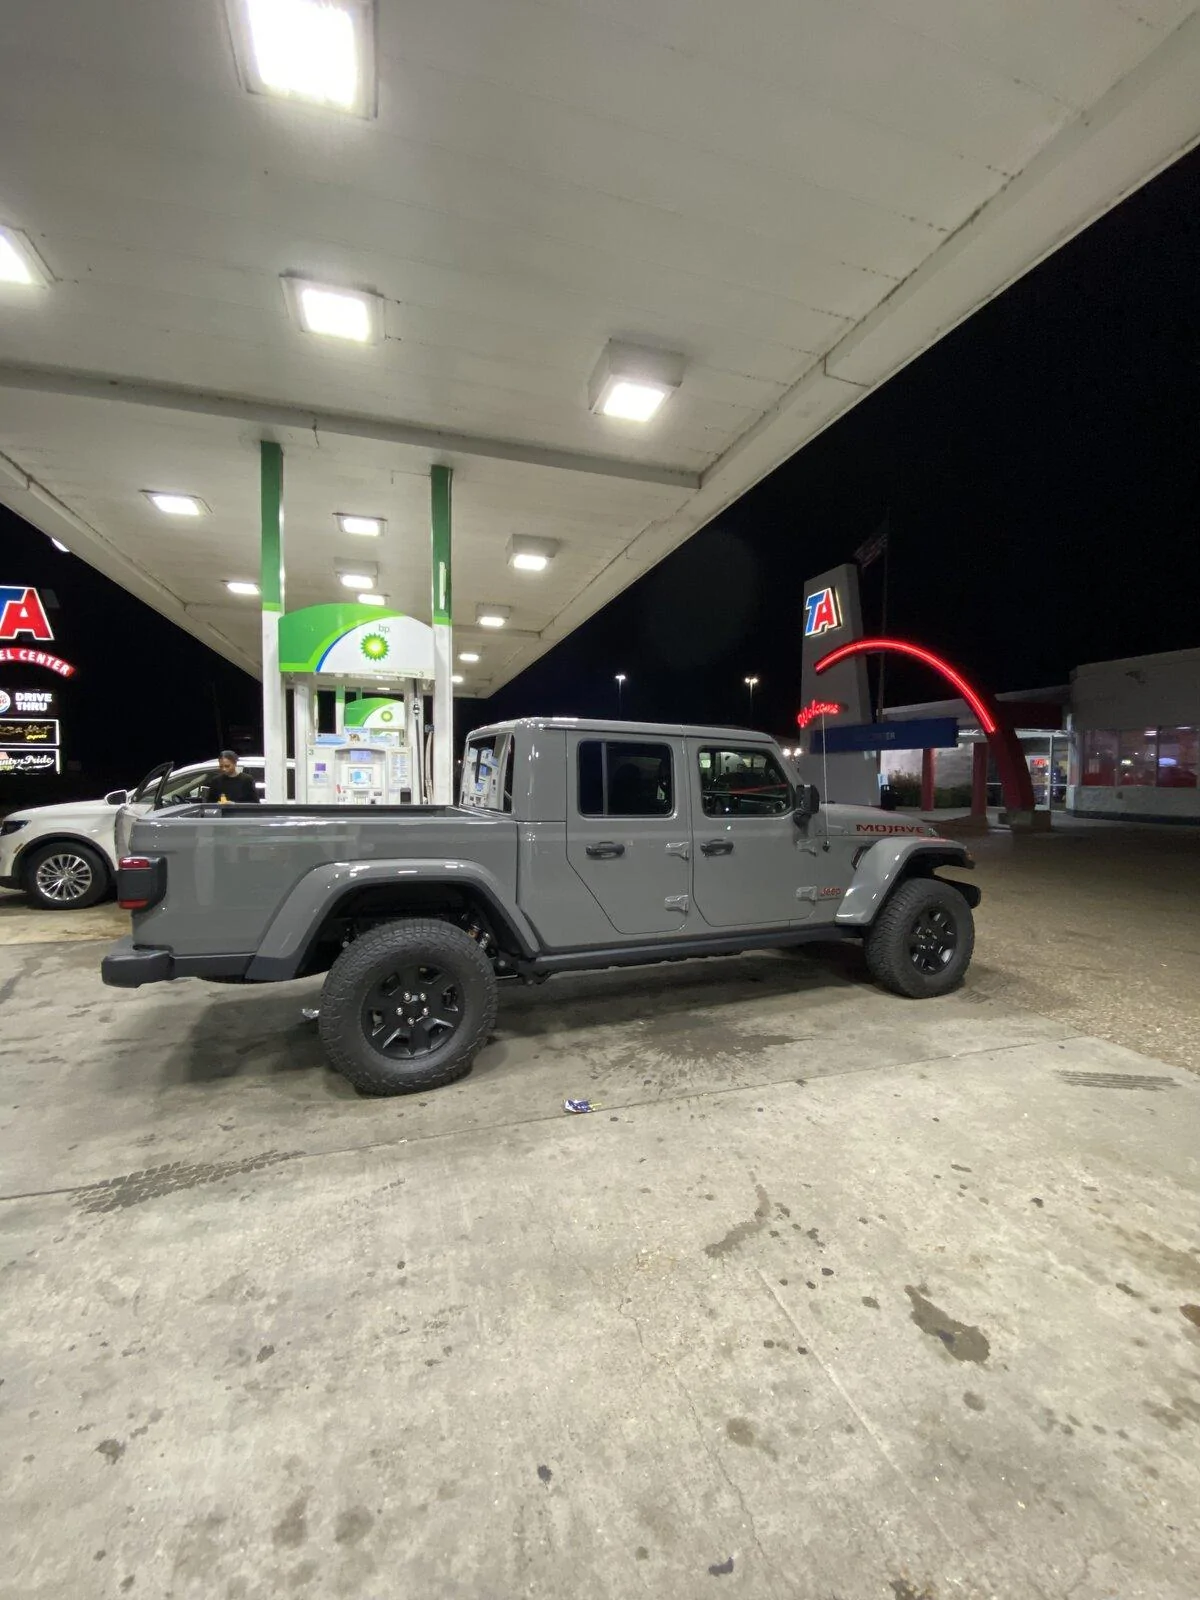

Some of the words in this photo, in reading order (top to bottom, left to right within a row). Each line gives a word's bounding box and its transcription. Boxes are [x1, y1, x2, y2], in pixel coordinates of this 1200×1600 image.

[805, 587, 838, 636] TA
[378, 623, 389, 634] bp
[19, 649, 70, 676] CENTER
[15, 692, 53, 702] DRIVE
[16, 702, 48, 711] THRU
[797, 699, 840, 728] Welcome
[856, 824, 925, 834] MOJAVE
